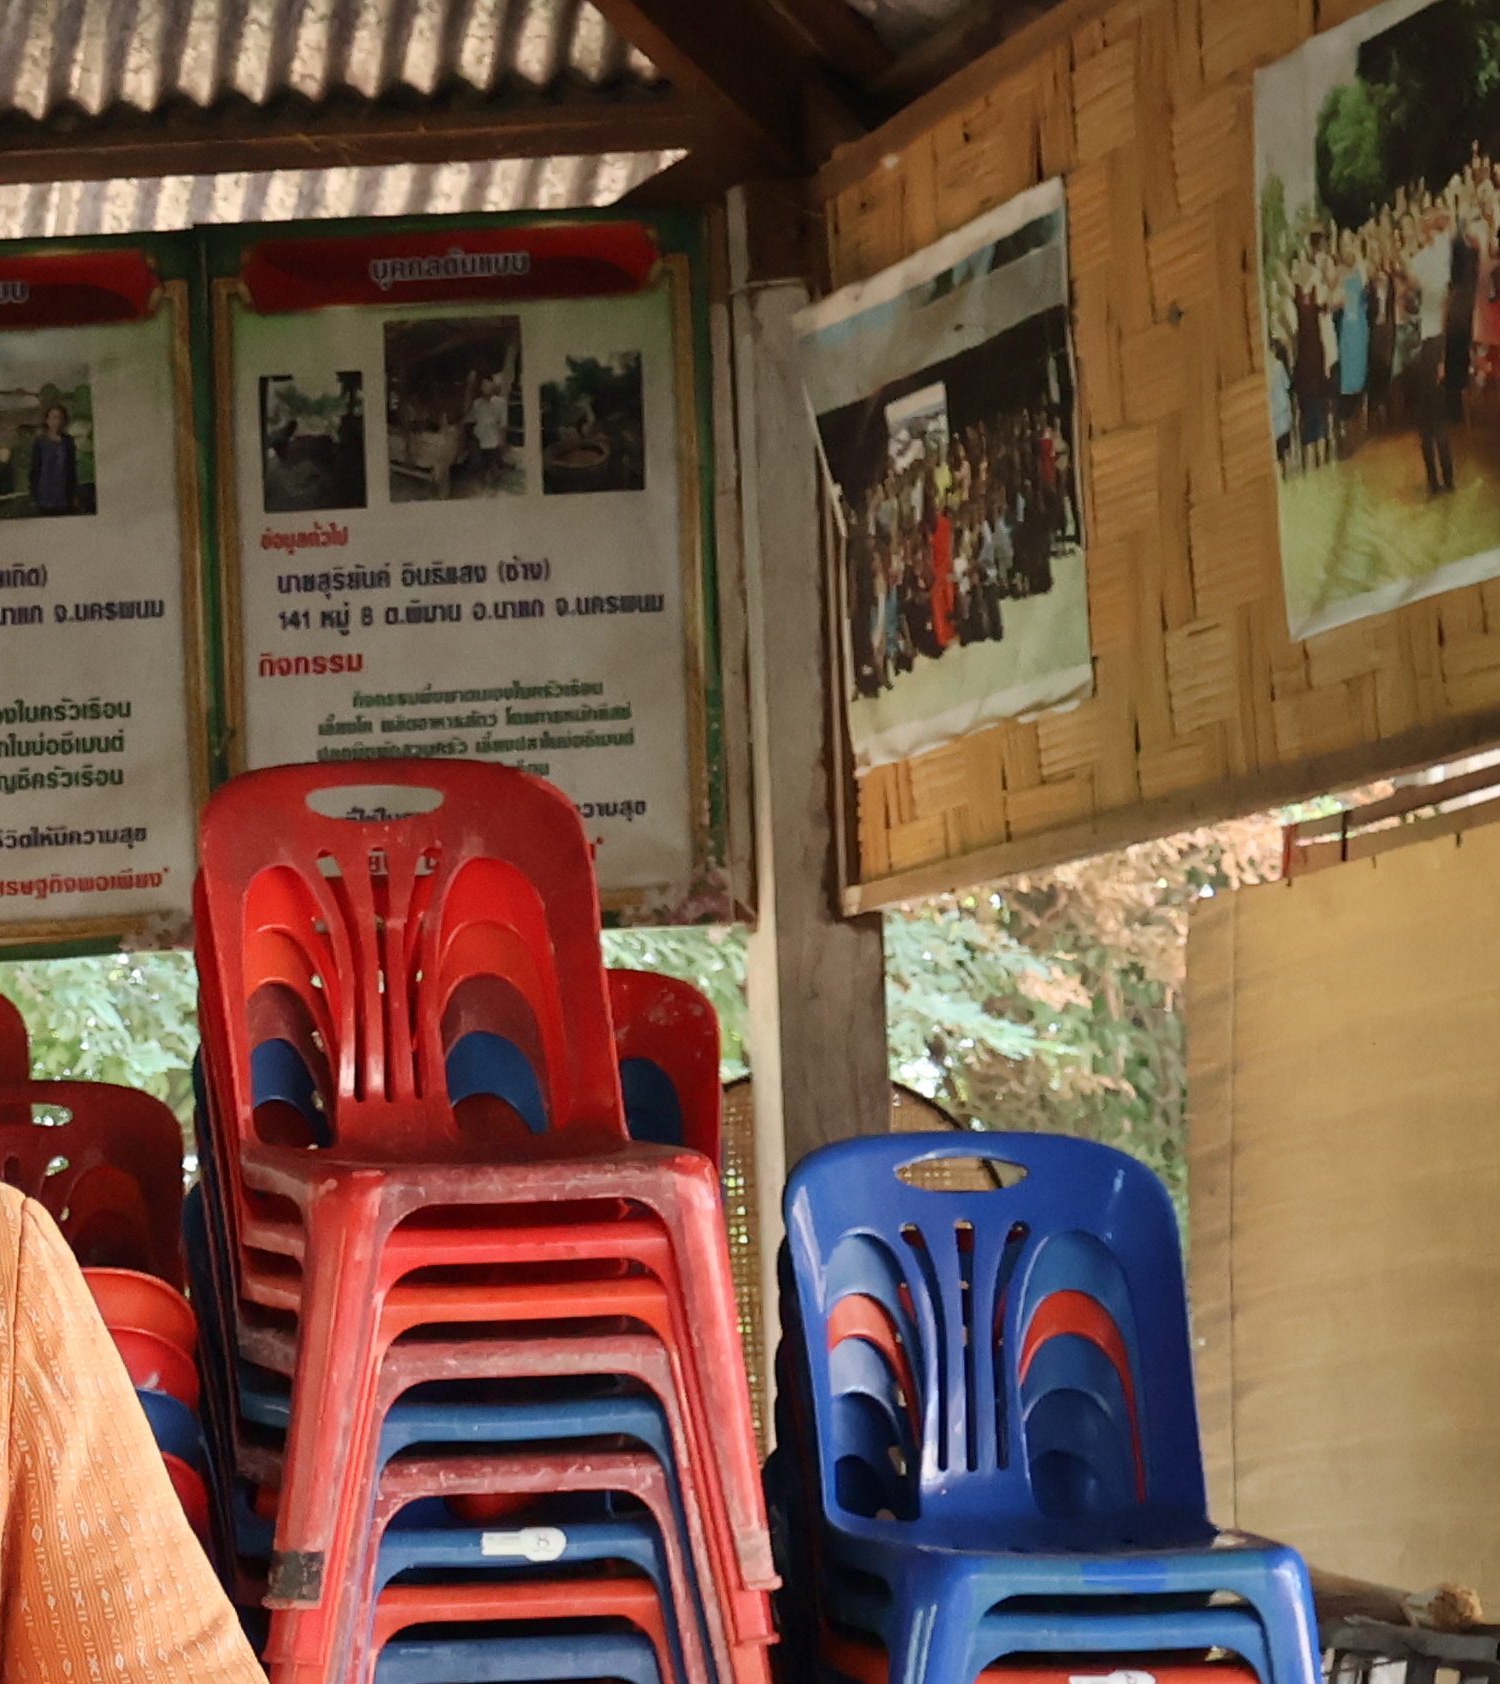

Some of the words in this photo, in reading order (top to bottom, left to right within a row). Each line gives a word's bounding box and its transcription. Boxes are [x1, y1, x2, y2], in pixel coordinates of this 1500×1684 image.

[278, 609, 311, 632] 141
[361, 605, 374, 627] 8
[258, 652, 364, 678] กิจกรรม
